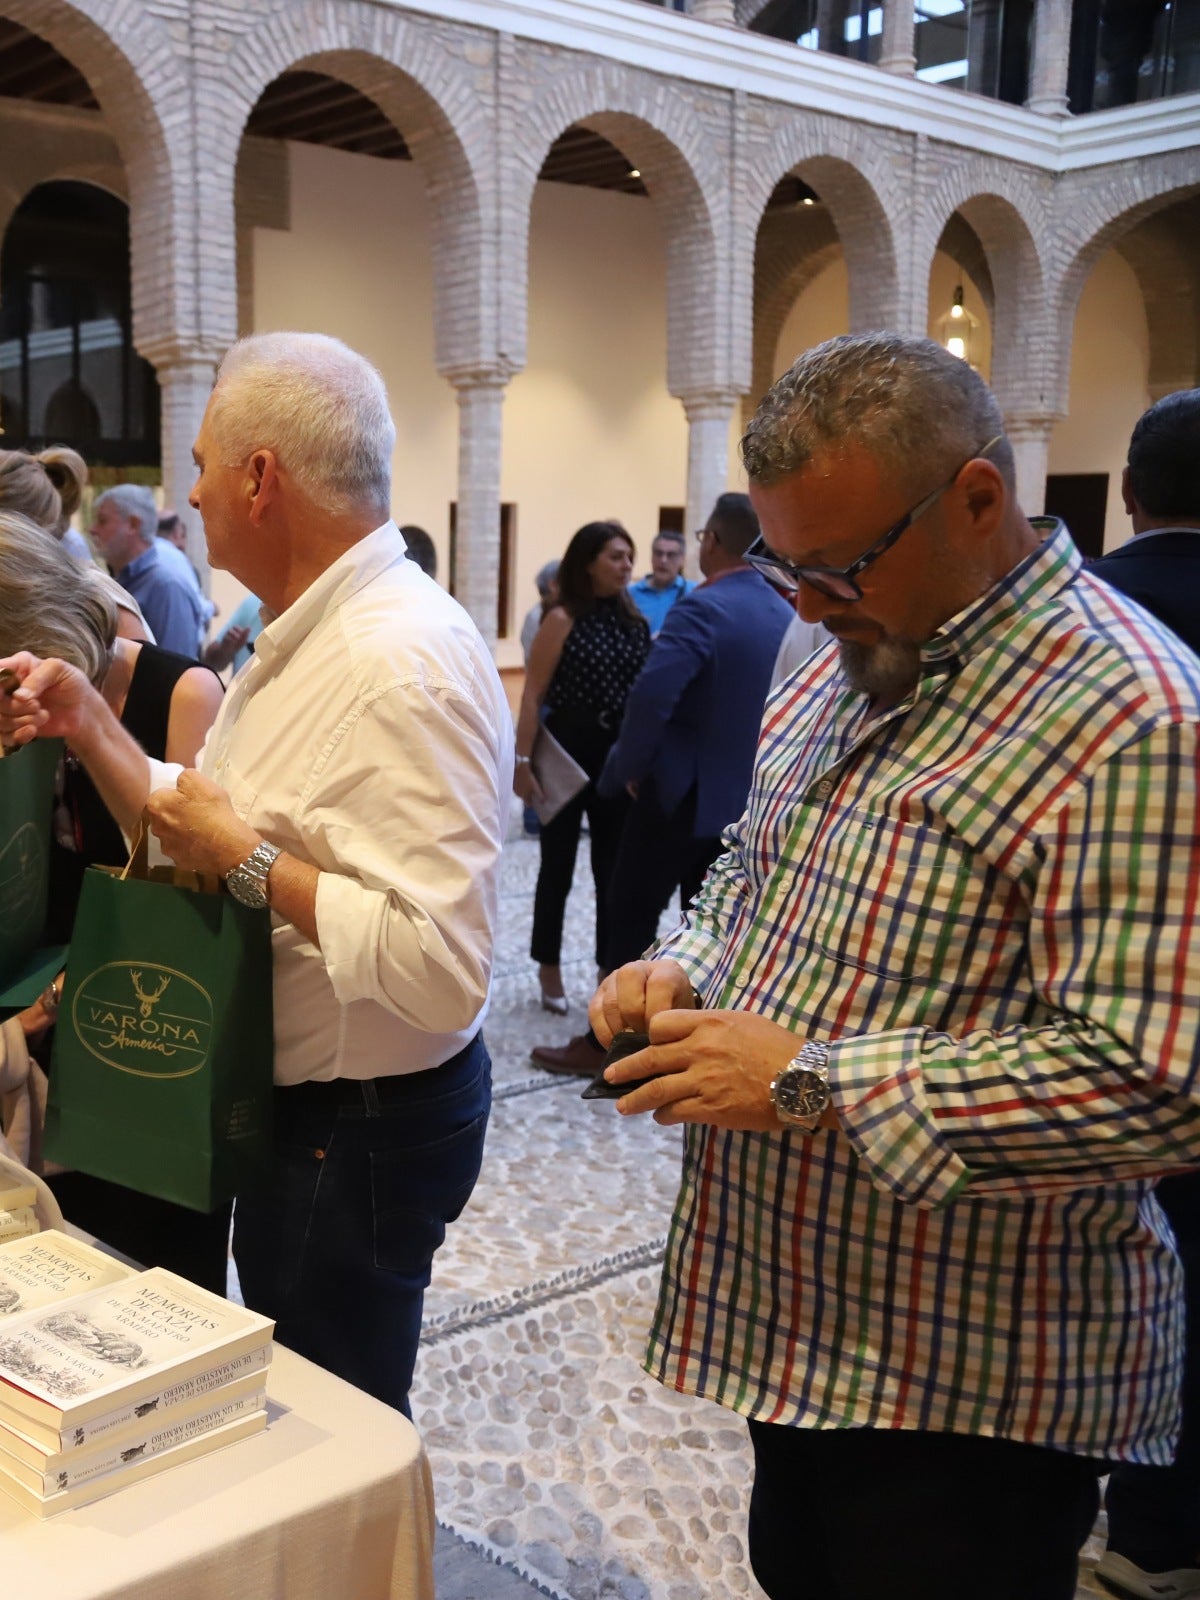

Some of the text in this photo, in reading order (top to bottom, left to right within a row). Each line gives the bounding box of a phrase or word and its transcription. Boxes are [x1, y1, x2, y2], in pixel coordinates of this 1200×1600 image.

[90, 1007, 200, 1044] VARONA
[98, 1029, 176, 1056] Armería
[2, 1266, 39, 1287] ARMERO
[18, 1254, 38, 1265] DE
[36, 1262, 72, 1283] CAZA
[25, 1267, 66, 1292] MAESTRO
[29, 1246, 95, 1281] MEMORIAS
[106, 1299, 191, 1343] DE UN MAESTRO
[130, 1298, 153, 1311] DE
[151, 1310, 193, 1333] CAZA
[136, 1287, 220, 1330] MEMORIAS
[112, 1314, 160, 1339] ARMERO
[17, 1330, 105, 1380] JOSÉ LUIS VARONA
[163, 1354, 253, 1400] DE UN MAESTRO ARMERO
[164, 1371, 234, 1407] MEMORIAS DE CAZA
[151, 1400, 245, 1445] DE UN MAESTRO ARMERO
